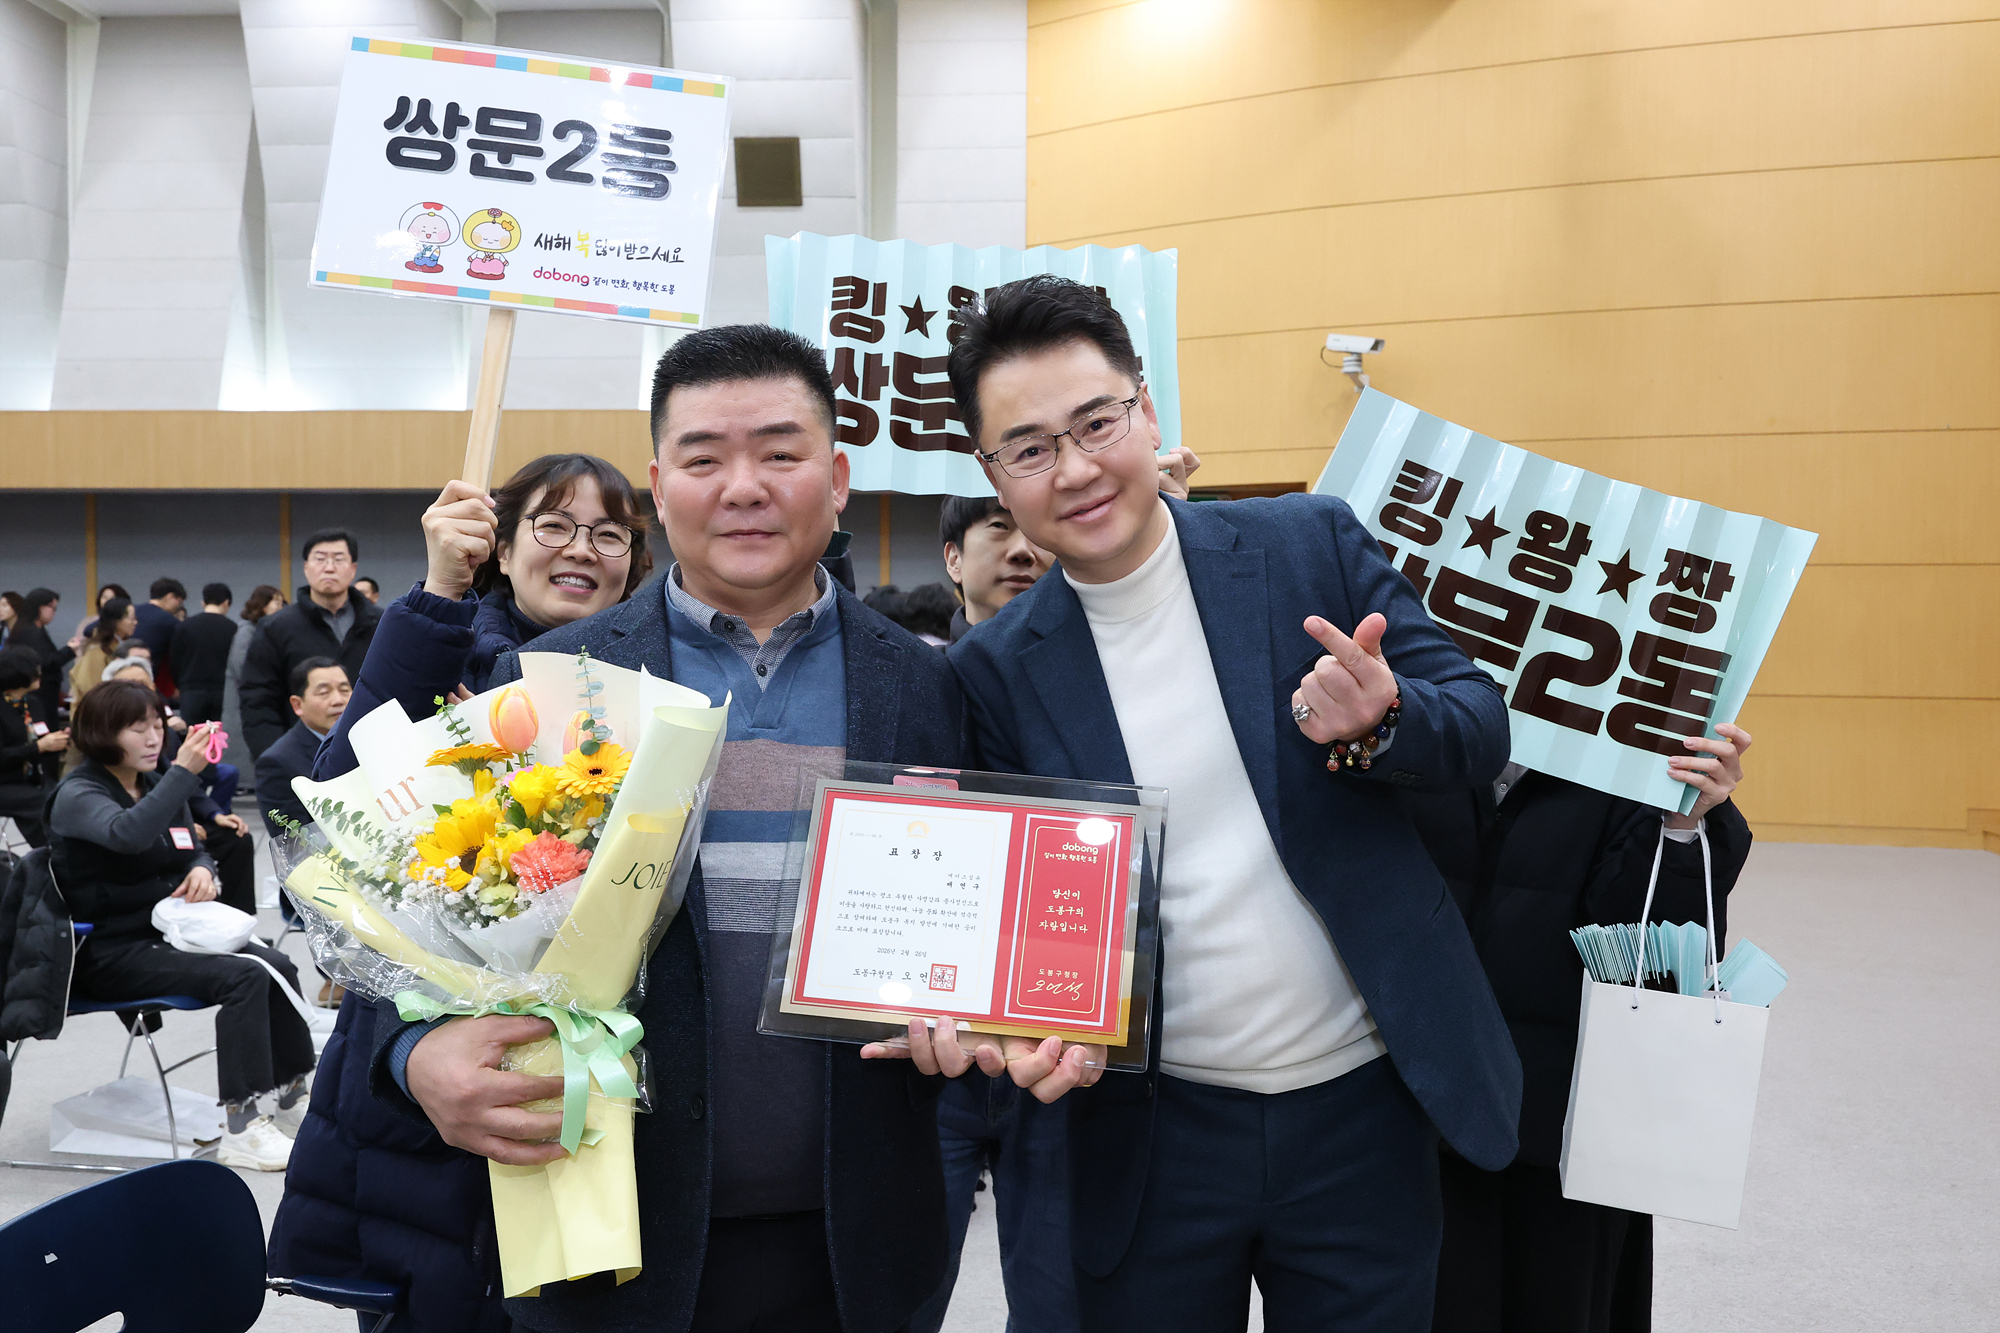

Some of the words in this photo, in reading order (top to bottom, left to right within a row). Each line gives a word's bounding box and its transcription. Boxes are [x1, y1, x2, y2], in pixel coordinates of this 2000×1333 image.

[383, 95, 678, 200] 쌍문2동
[534, 233, 571, 251] 새해
[575, 229, 591, 258] 복
[624, 242, 684, 263] 받으세요
[533, 266, 590, 287] dobong
[593, 276, 608, 286] 같이
[632, 280, 659, 293] 행복한
[661, 284, 675, 295] 도봉
[830, 275, 888, 344] 킹
[1379, 459, 1463, 546] 킹
[1508, 510, 1593, 593] 왕
[1649, 548, 1735, 633] 짱
[1376, 540, 1733, 757] 문2동
[1062, 842, 1099, 855] dobong
[1052, 888, 1081, 901] 당신이
[1045, 905, 1084, 917] 도봉구의
[1038, 919, 1088, 934] 자랑입니다
[853, 968, 893, 980] 도봉구청장
[1039, 968, 1079, 979] 도봉구청장
